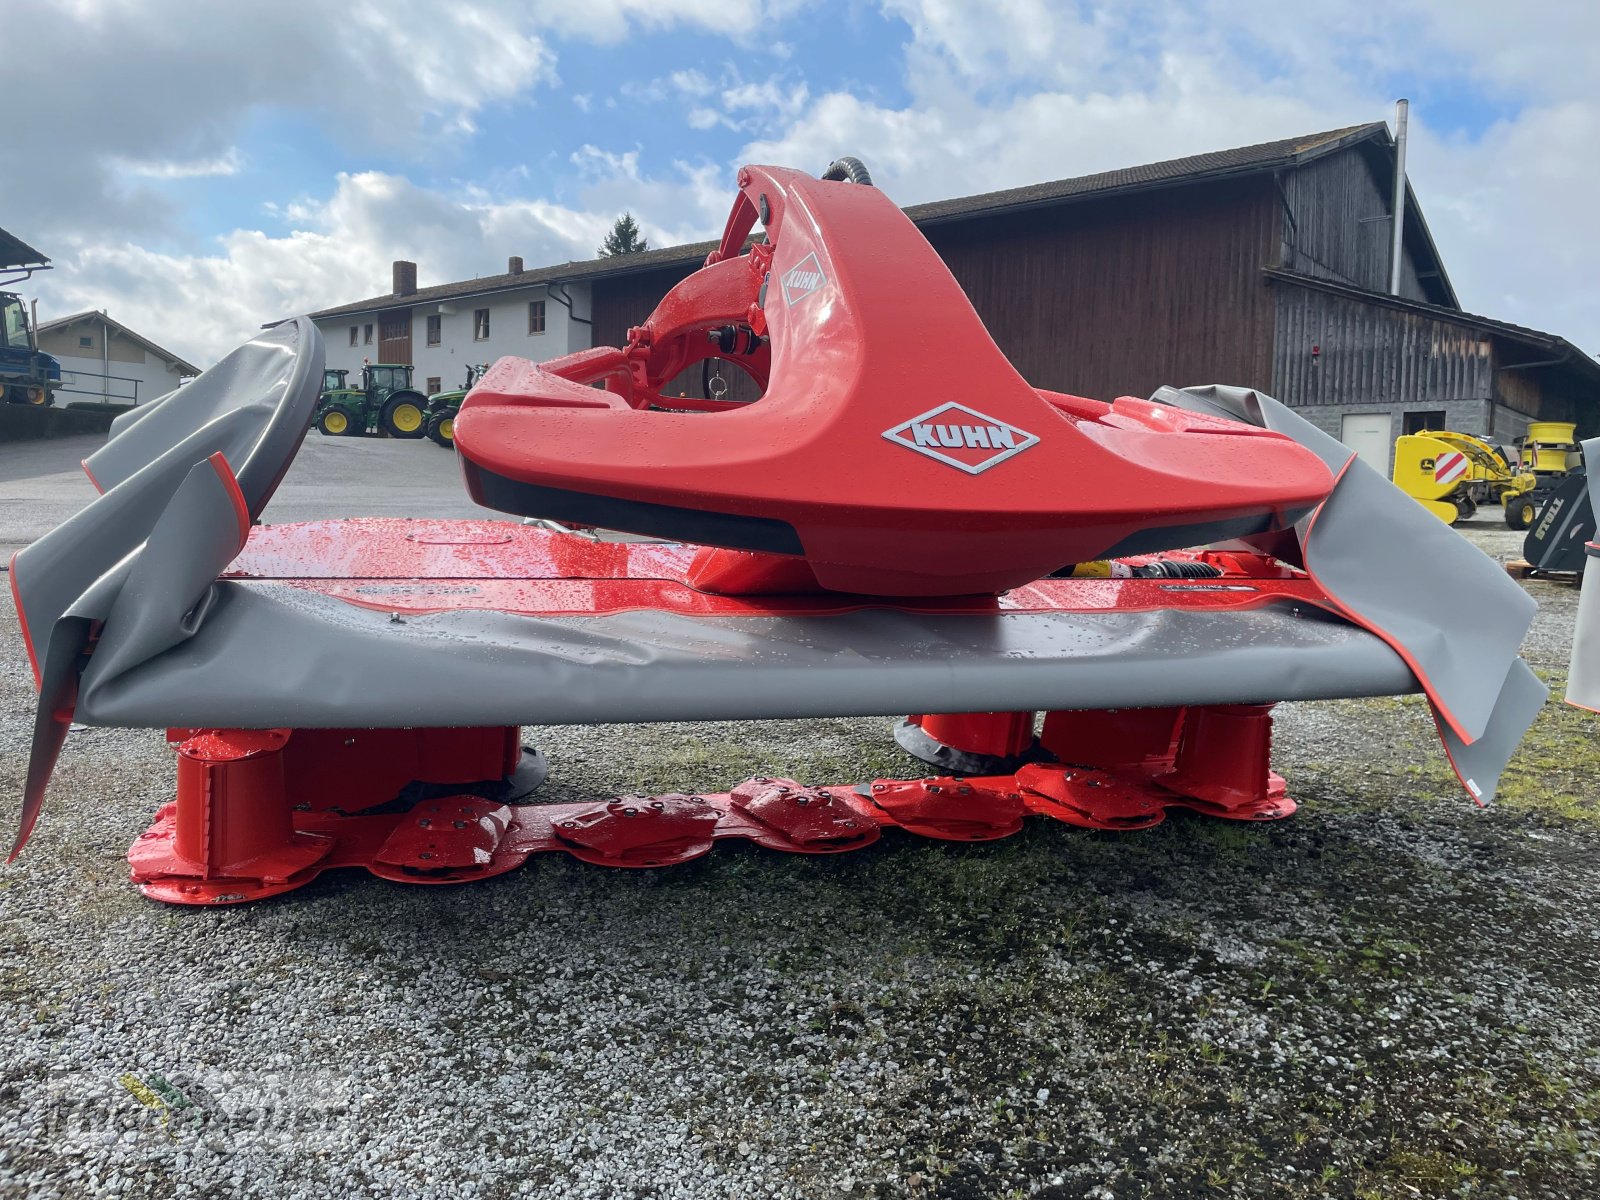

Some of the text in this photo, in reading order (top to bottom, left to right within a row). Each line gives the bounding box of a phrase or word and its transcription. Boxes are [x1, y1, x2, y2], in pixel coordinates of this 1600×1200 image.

[787, 270, 821, 290] KUHN
[910, 423, 1017, 449] KUHN
[1534, 497, 1565, 541] STOLL
